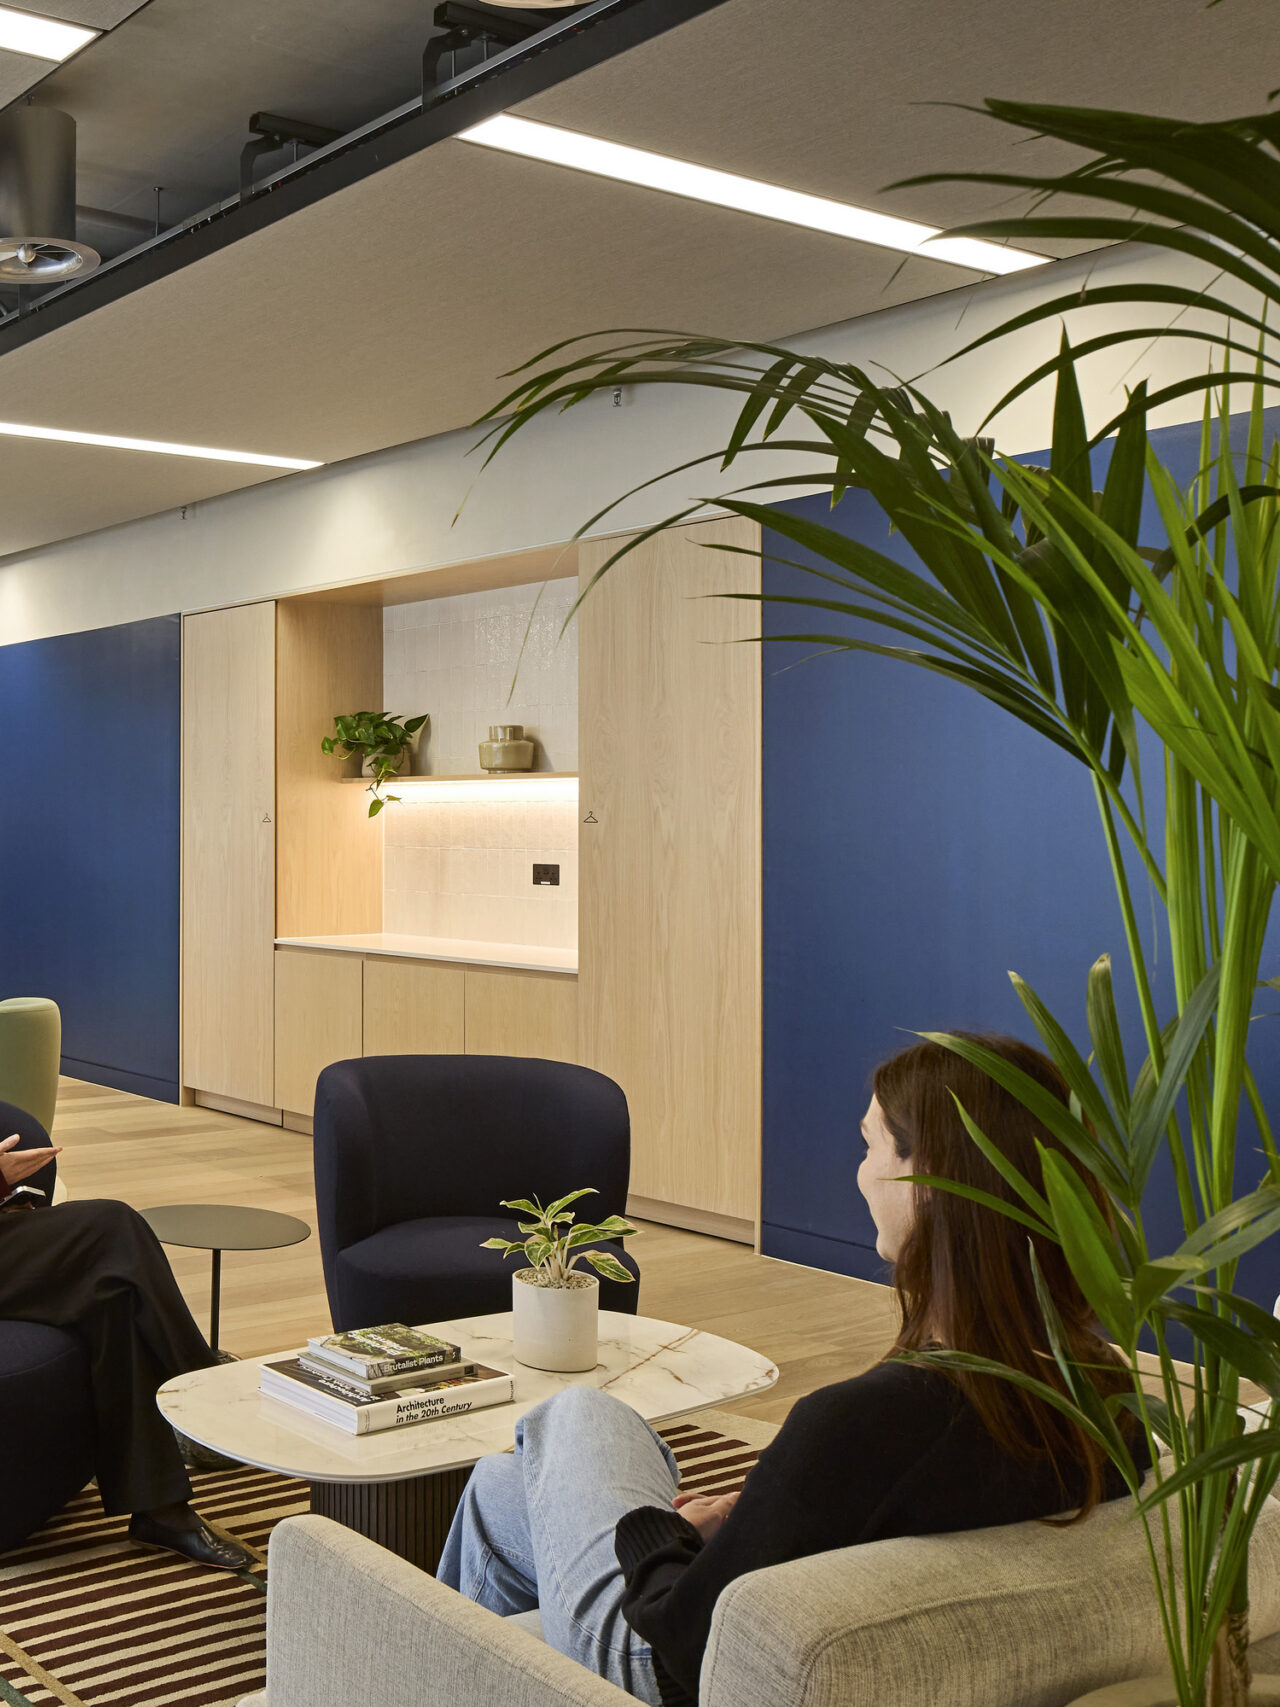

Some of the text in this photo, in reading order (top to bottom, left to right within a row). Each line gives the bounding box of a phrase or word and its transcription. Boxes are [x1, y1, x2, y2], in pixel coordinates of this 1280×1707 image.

[383, 1360, 417, 1372] Brutalist
[418, 1354, 443, 1366] Plants
[395, 1402, 473, 1424] in the 20th Century
[396, 1397, 444, 1414] Architecture
